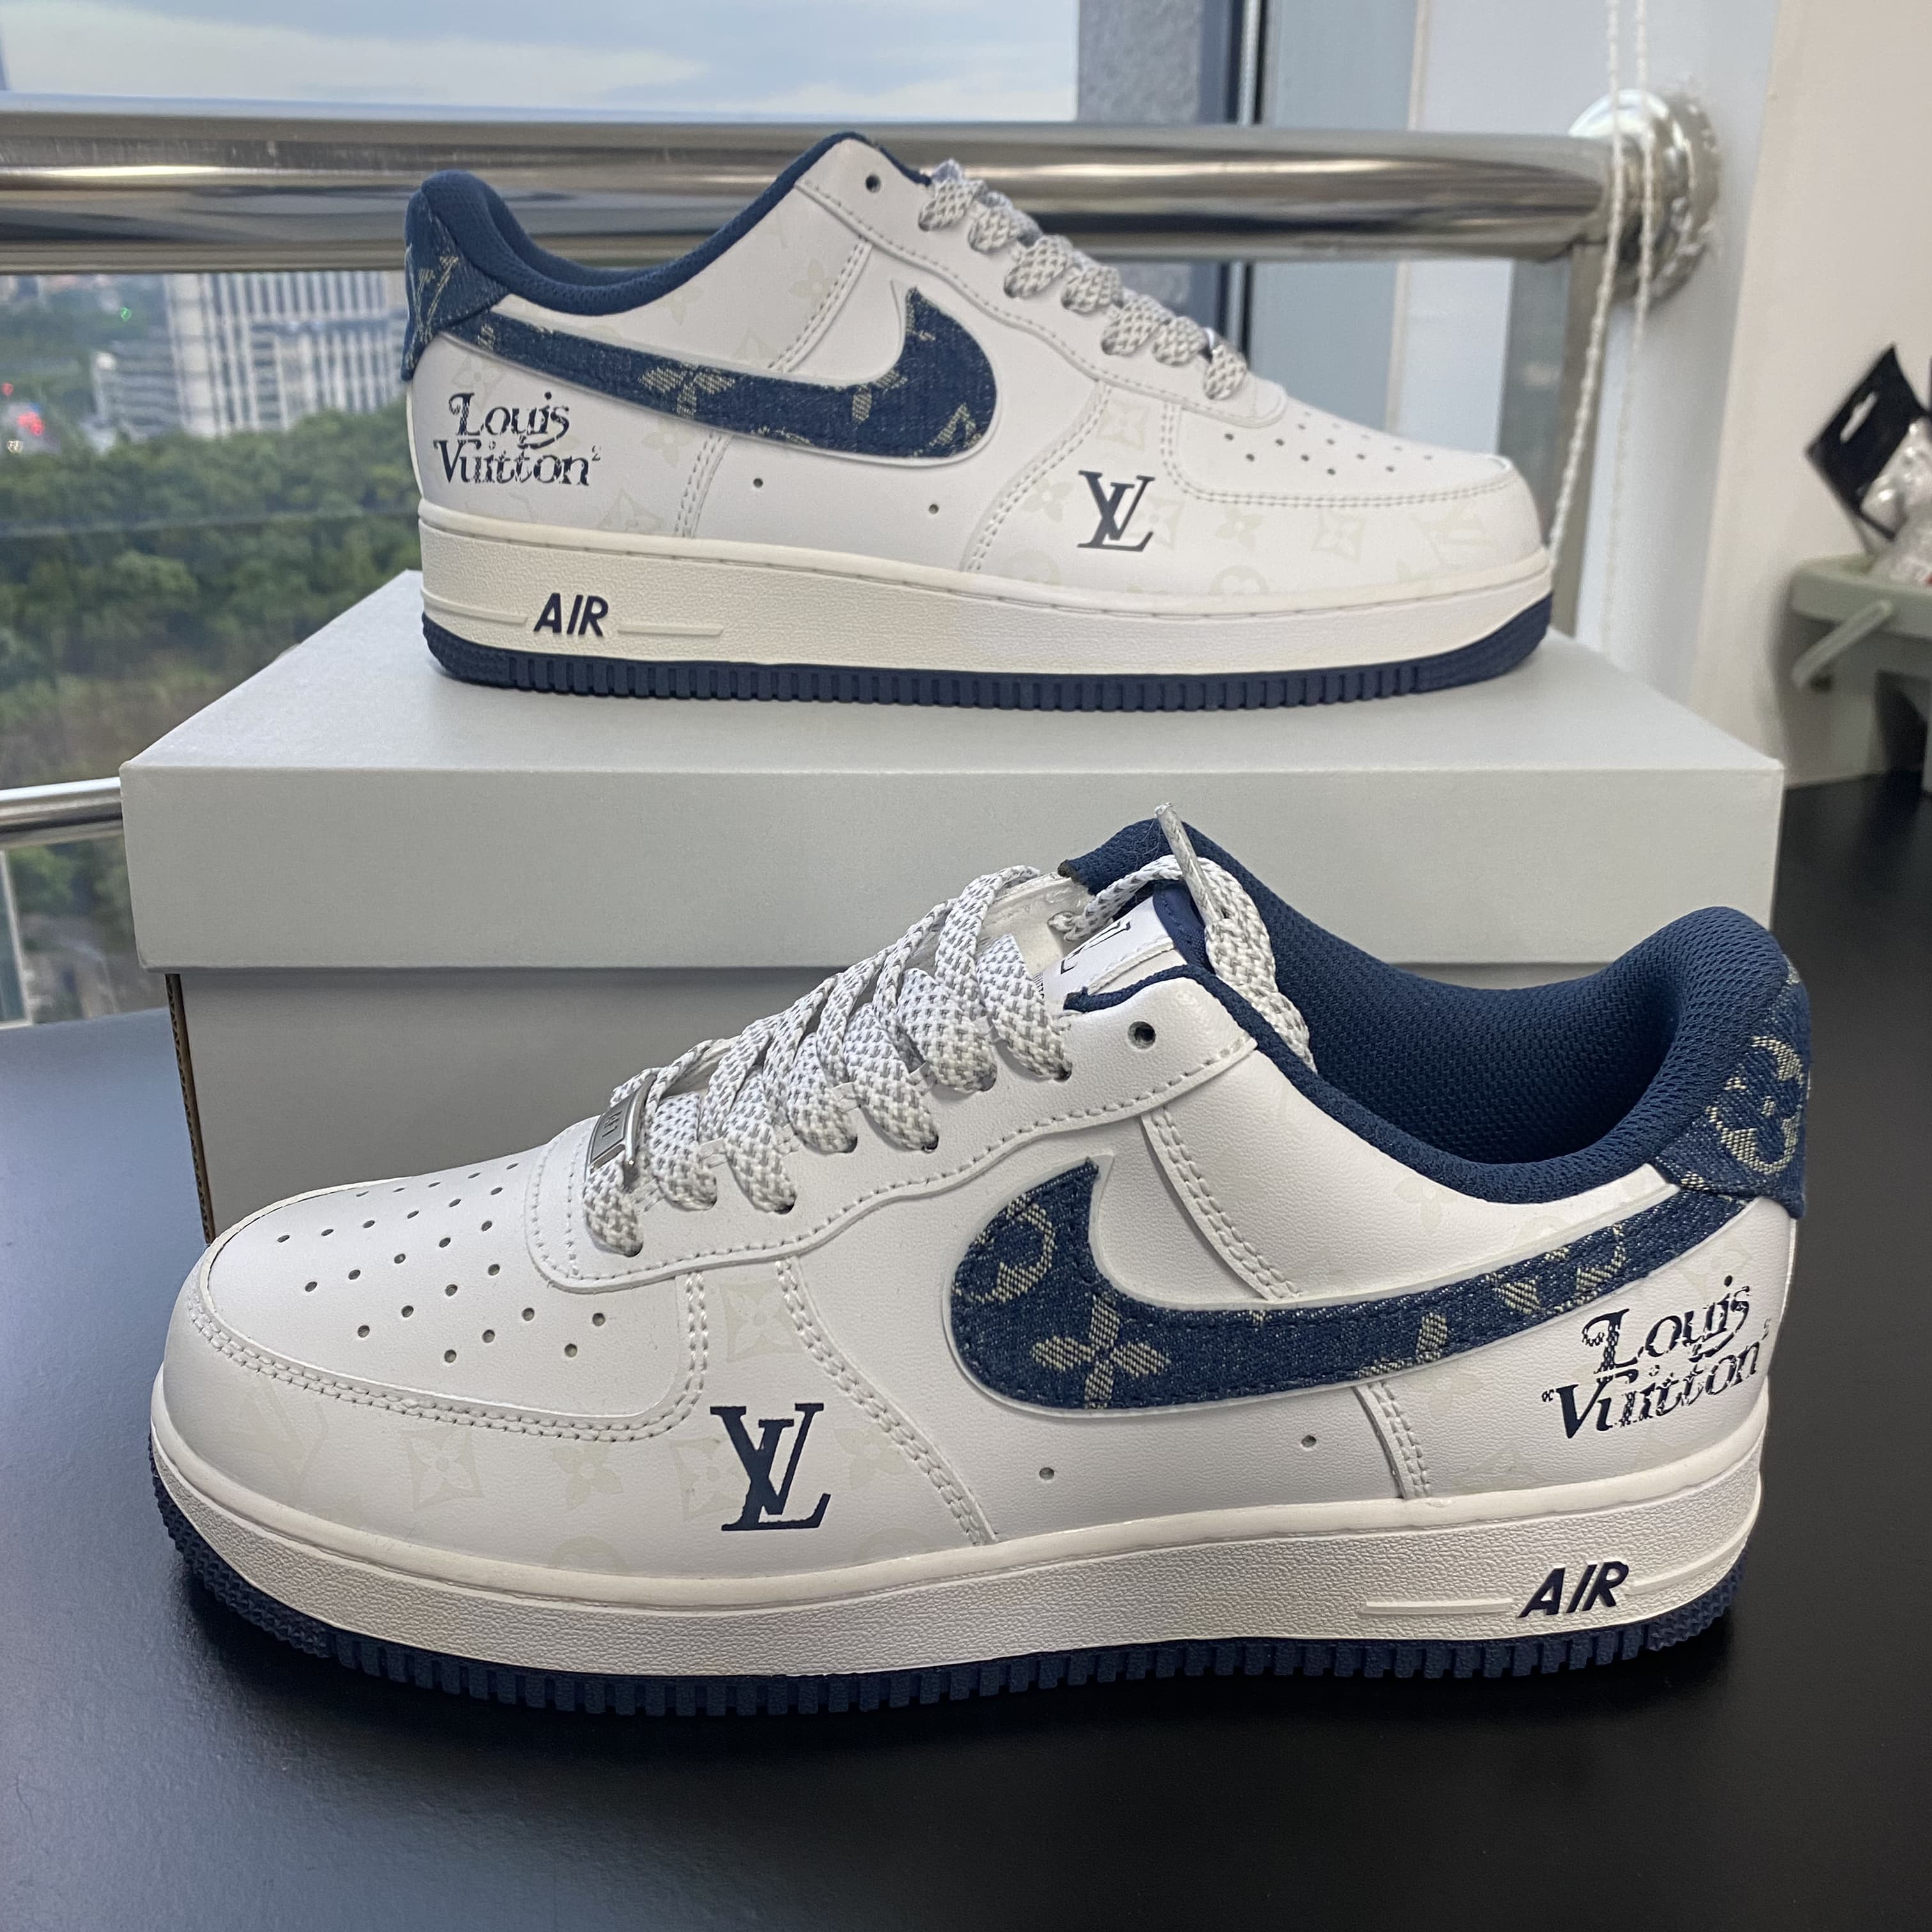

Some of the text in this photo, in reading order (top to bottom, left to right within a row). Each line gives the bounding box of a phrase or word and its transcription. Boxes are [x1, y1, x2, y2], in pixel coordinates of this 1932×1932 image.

[448, 392, 570, 449] Louis
[533, 592, 609, 637] AIR
[1581, 1275, 1750, 1374] Louis
[1517, 1561, 1629, 1618] AIR
